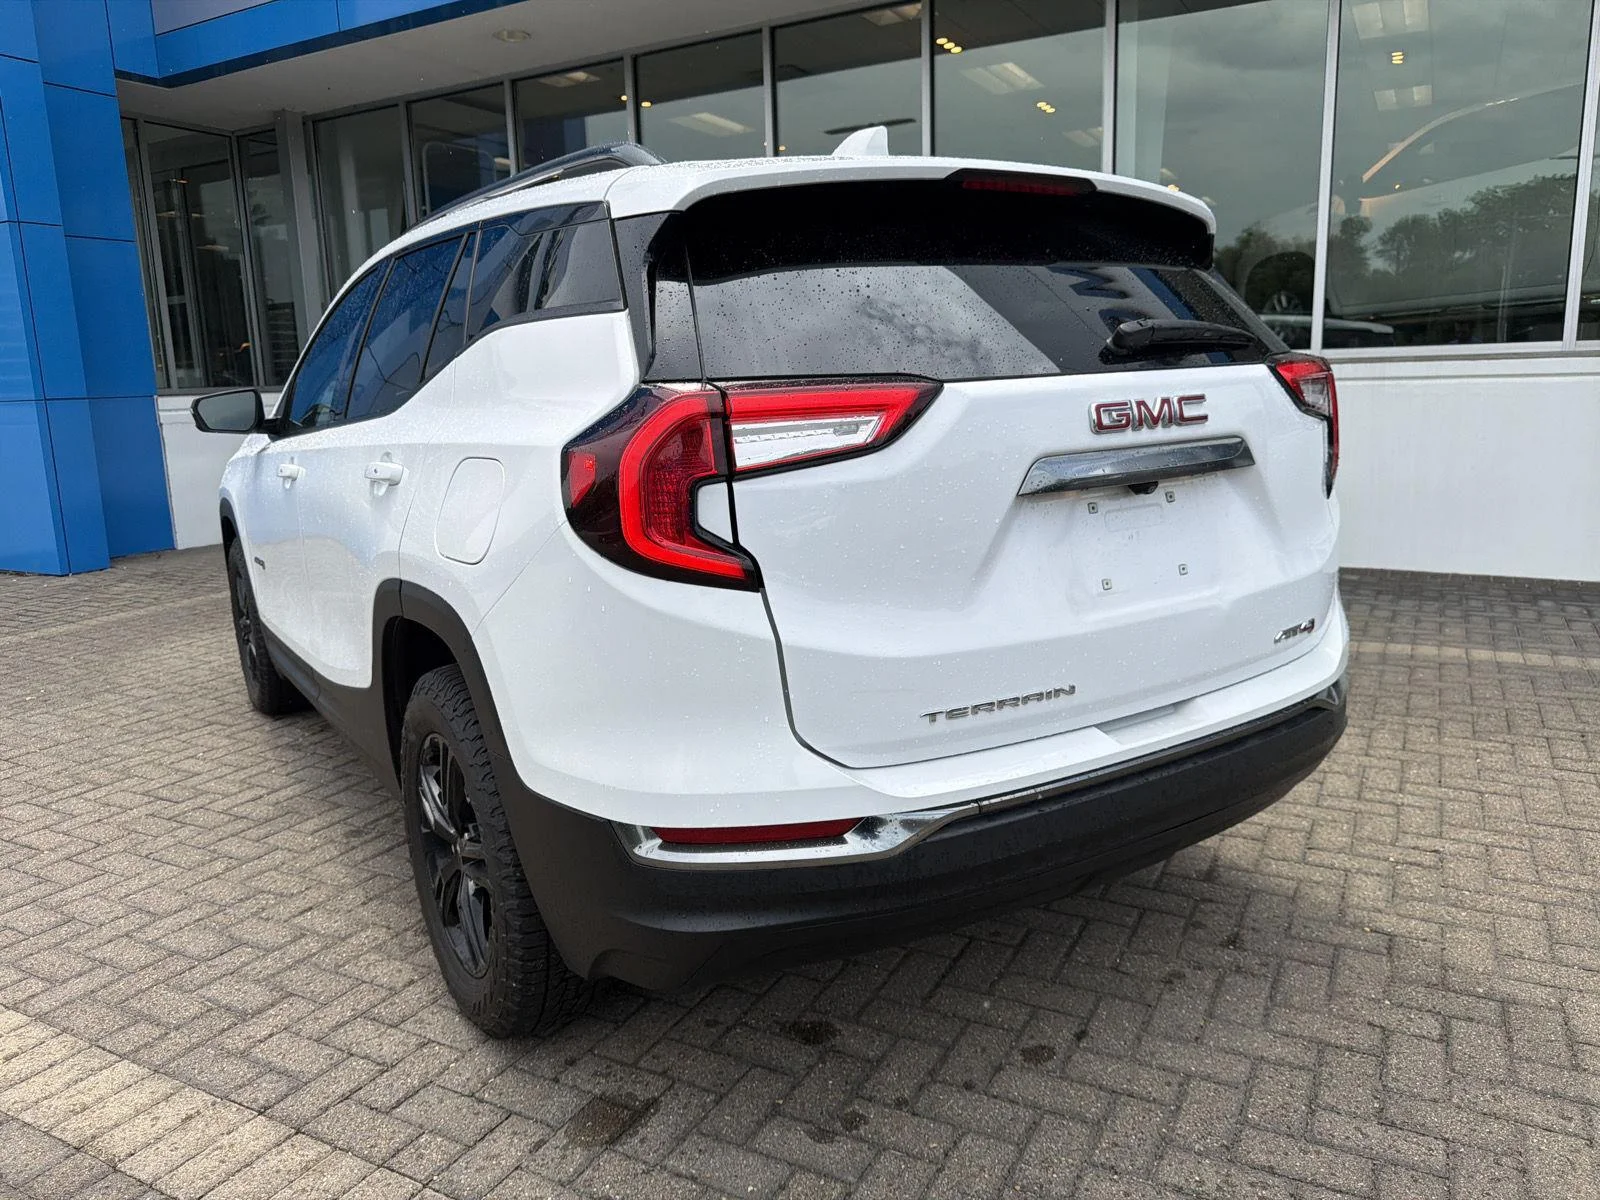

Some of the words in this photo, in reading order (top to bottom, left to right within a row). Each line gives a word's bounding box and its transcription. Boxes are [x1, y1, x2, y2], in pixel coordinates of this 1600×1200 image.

[1088, 394, 1209, 434] GMC
[1273, 617, 1315, 644] AT4
[920, 684, 1076, 723] TERRAIN
